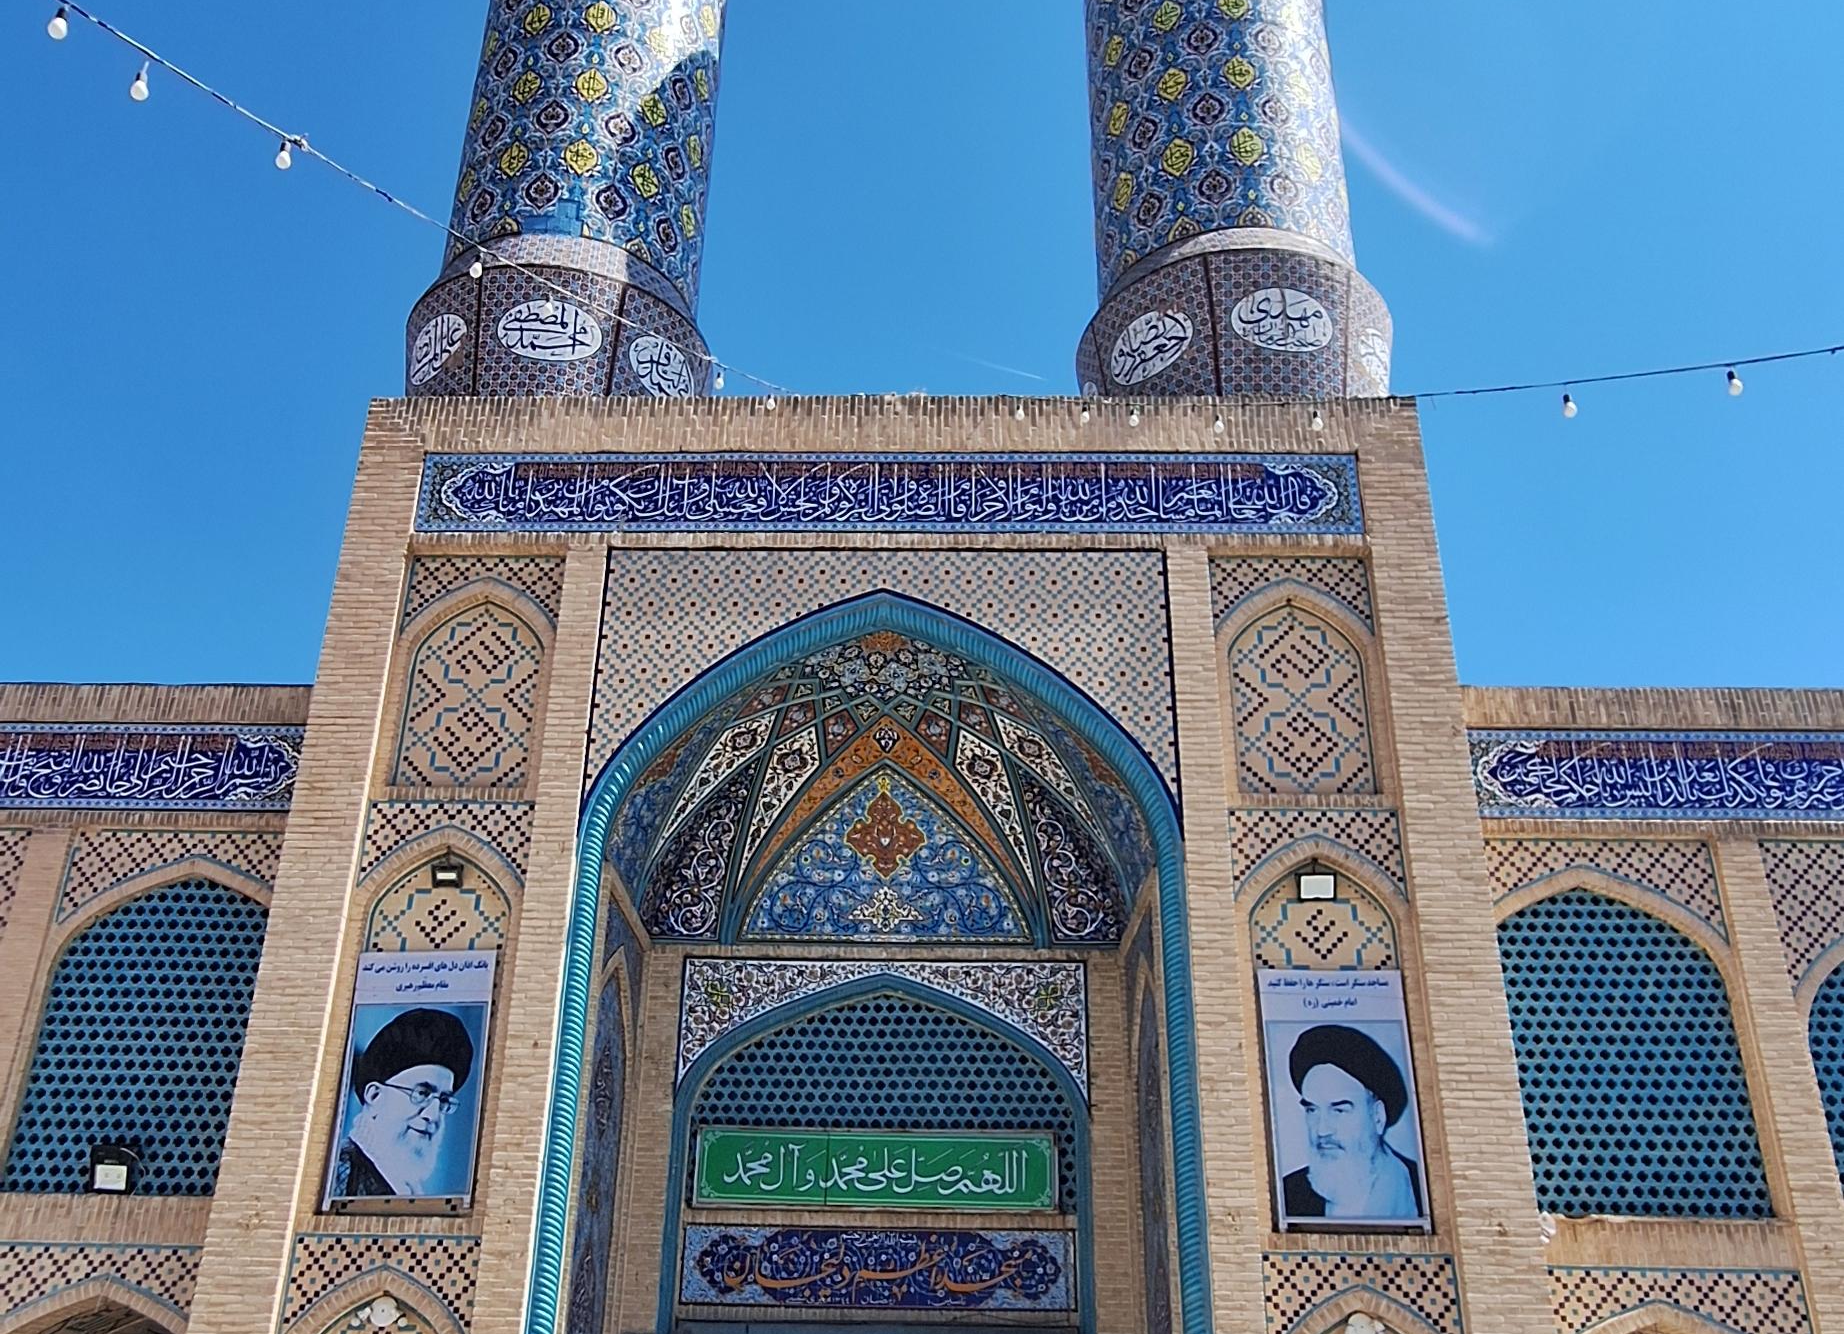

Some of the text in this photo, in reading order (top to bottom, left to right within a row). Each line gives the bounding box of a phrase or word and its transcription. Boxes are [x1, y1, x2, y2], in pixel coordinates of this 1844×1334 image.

[386, 963, 405, 974] روشن
[395, 979, 449, 993] مقام معظم رهبری
[1267, 978, 1282, 988] کنید
[1283, 978, 1298, 988] حفظ
[1366, 978, 1389, 989] مساجد
[1321, 999, 1343, 1010] خمینی
[1343, 997, 1357, 1009] امام
